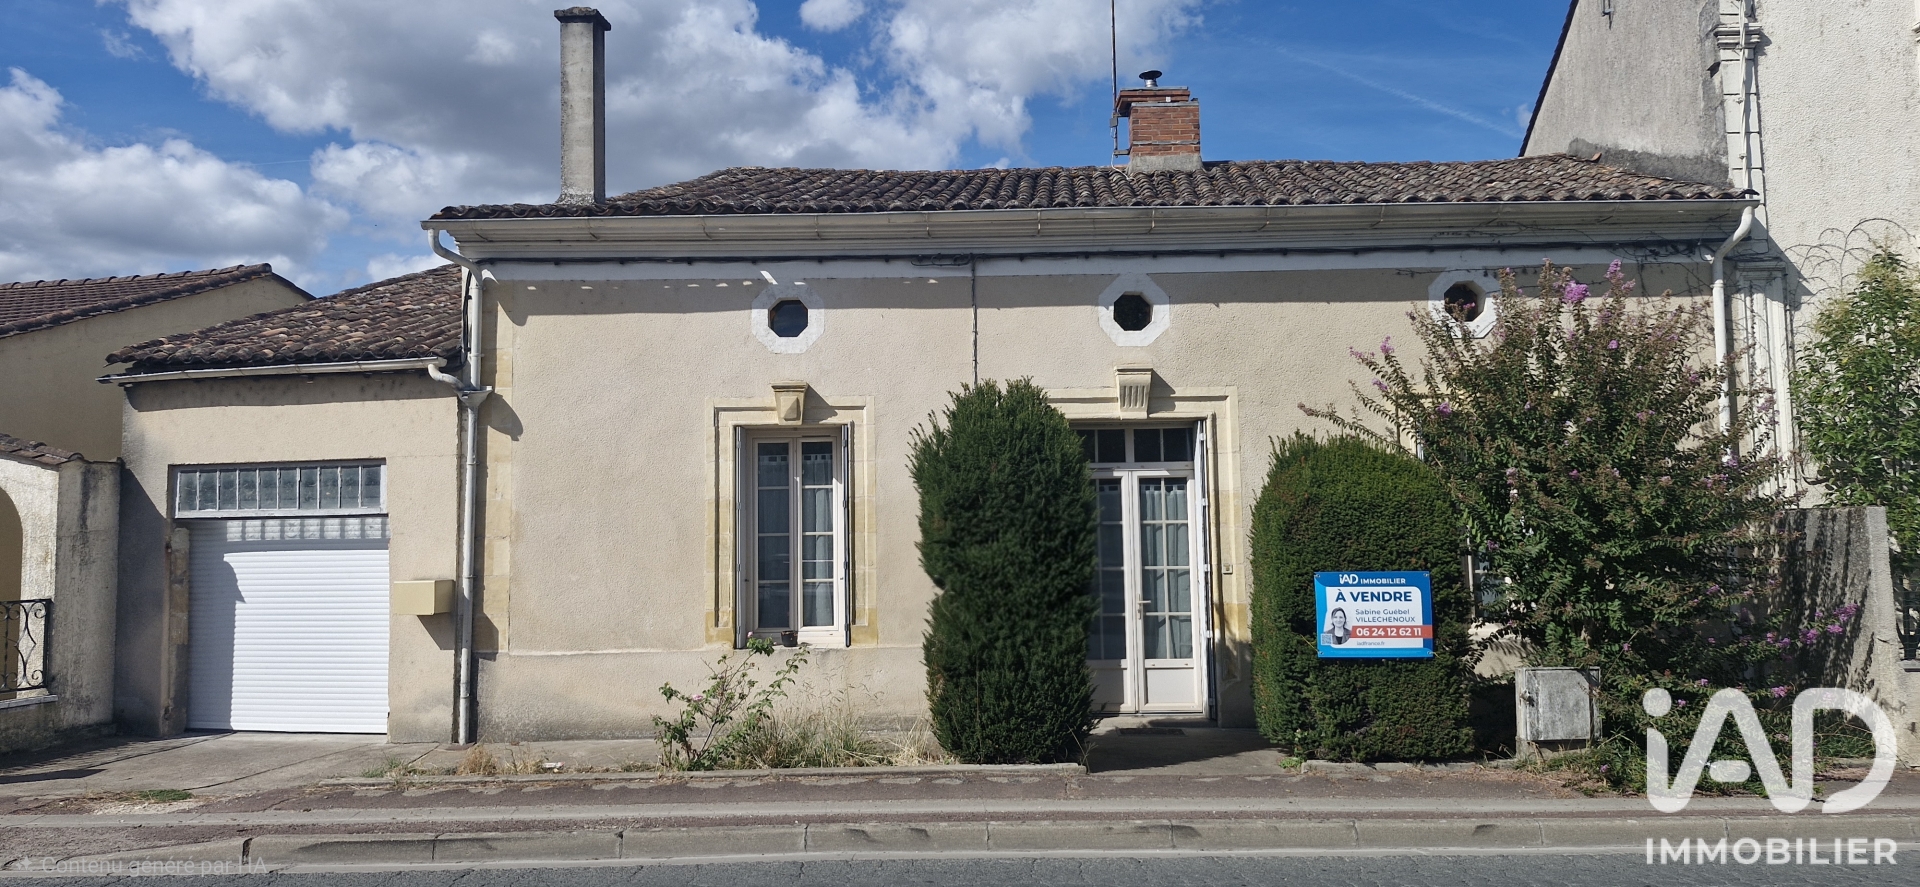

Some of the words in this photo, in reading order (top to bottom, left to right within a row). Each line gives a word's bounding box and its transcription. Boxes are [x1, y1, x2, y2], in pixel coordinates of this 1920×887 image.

[1335, 589, 1347, 602] À
[1350, 591, 1412, 602] VENDRE
[1356, 627, 1370, 636] 06
[1371, 627, 1385, 636] 24
[1387, 627, 1397, 636] 12
[1399, 627, 1412, 636] 62
[1413, 627, 1422, 636] 11
